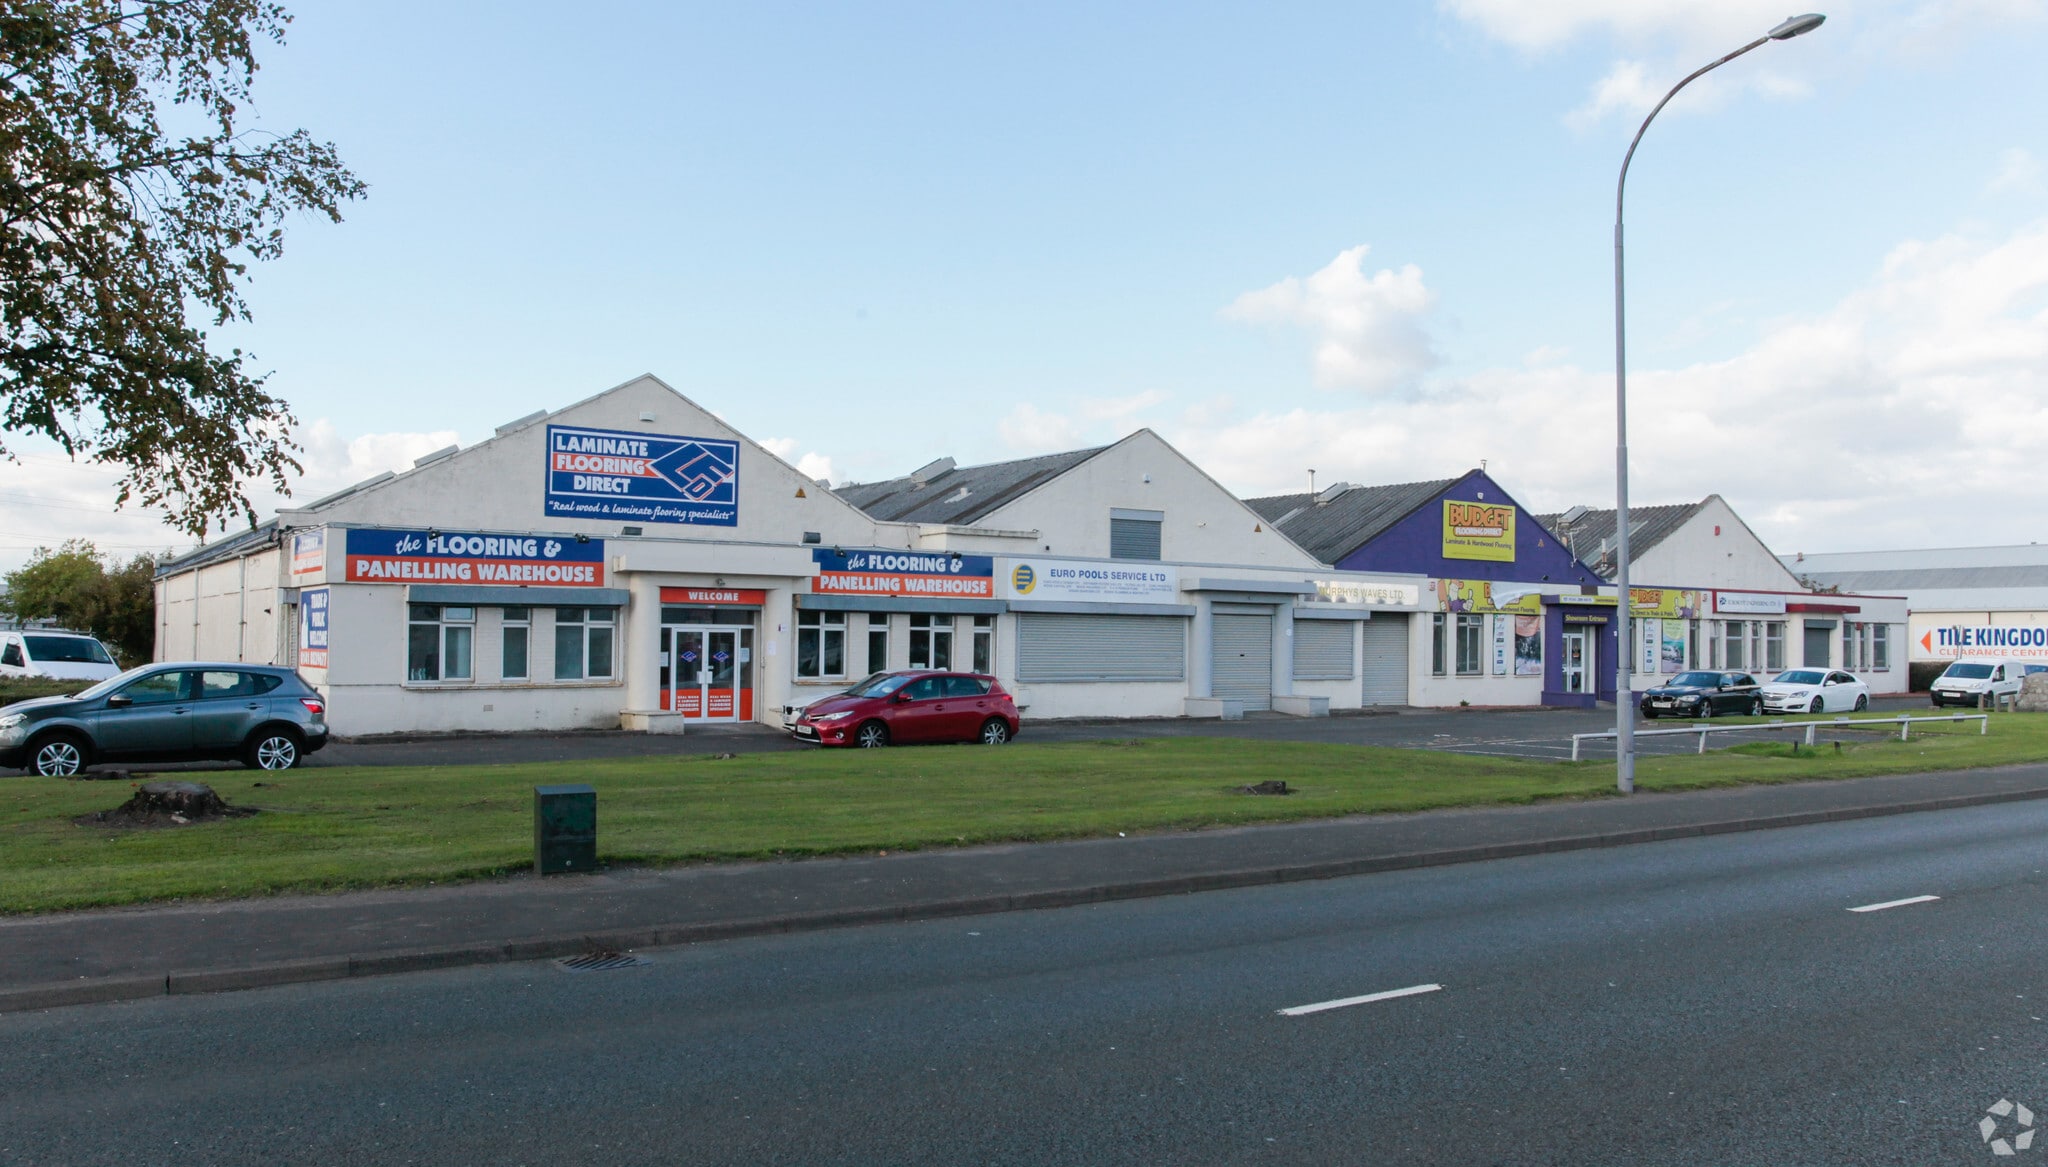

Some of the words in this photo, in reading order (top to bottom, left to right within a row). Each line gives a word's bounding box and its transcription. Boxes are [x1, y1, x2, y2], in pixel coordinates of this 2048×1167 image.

[557, 435, 648, 456] LAMINATE
[557, 454, 645, 475] FLOORING
[574, 475, 631, 493] DIRECT
[576, 503, 600, 512] wood
[602, 505, 610, 513] &
[612, 504, 653, 516] laminate
[651, 506, 687, 522] flooring
[1449, 503, 1512, 531] BUDGET
[395, 534, 421, 555] the
[426, 536, 537, 557] FLOORING
[543, 540, 561, 558] &
[356, 559, 471, 580] PANELLING
[477, 564, 594, 582] WAREHOUSE
[848, 554, 866, 570] the
[868, 554, 946, 573] FLOORING
[950, 557, 963, 573] &
[820, 575, 900, 591] PANELLING
[904, 578, 987, 594] WAREHOUSE
[1050, 568, 1075, 578] EURO
[1079, 569, 1108, 579] POOLS
[1111, 571, 1147, 581] SERVICE
[1150, 573, 1166, 582] LTD
[688, 591, 739, 602] WELCOME
[1320, 586, 1359, 597] MURPHYS
[1361, 588, 1387, 598] WAVES
[1937, 628, 1972, 646] TILE
[1976, 628, 2048, 647] KINGDO
[1939, 648, 2008, 657] CLEARANCE
